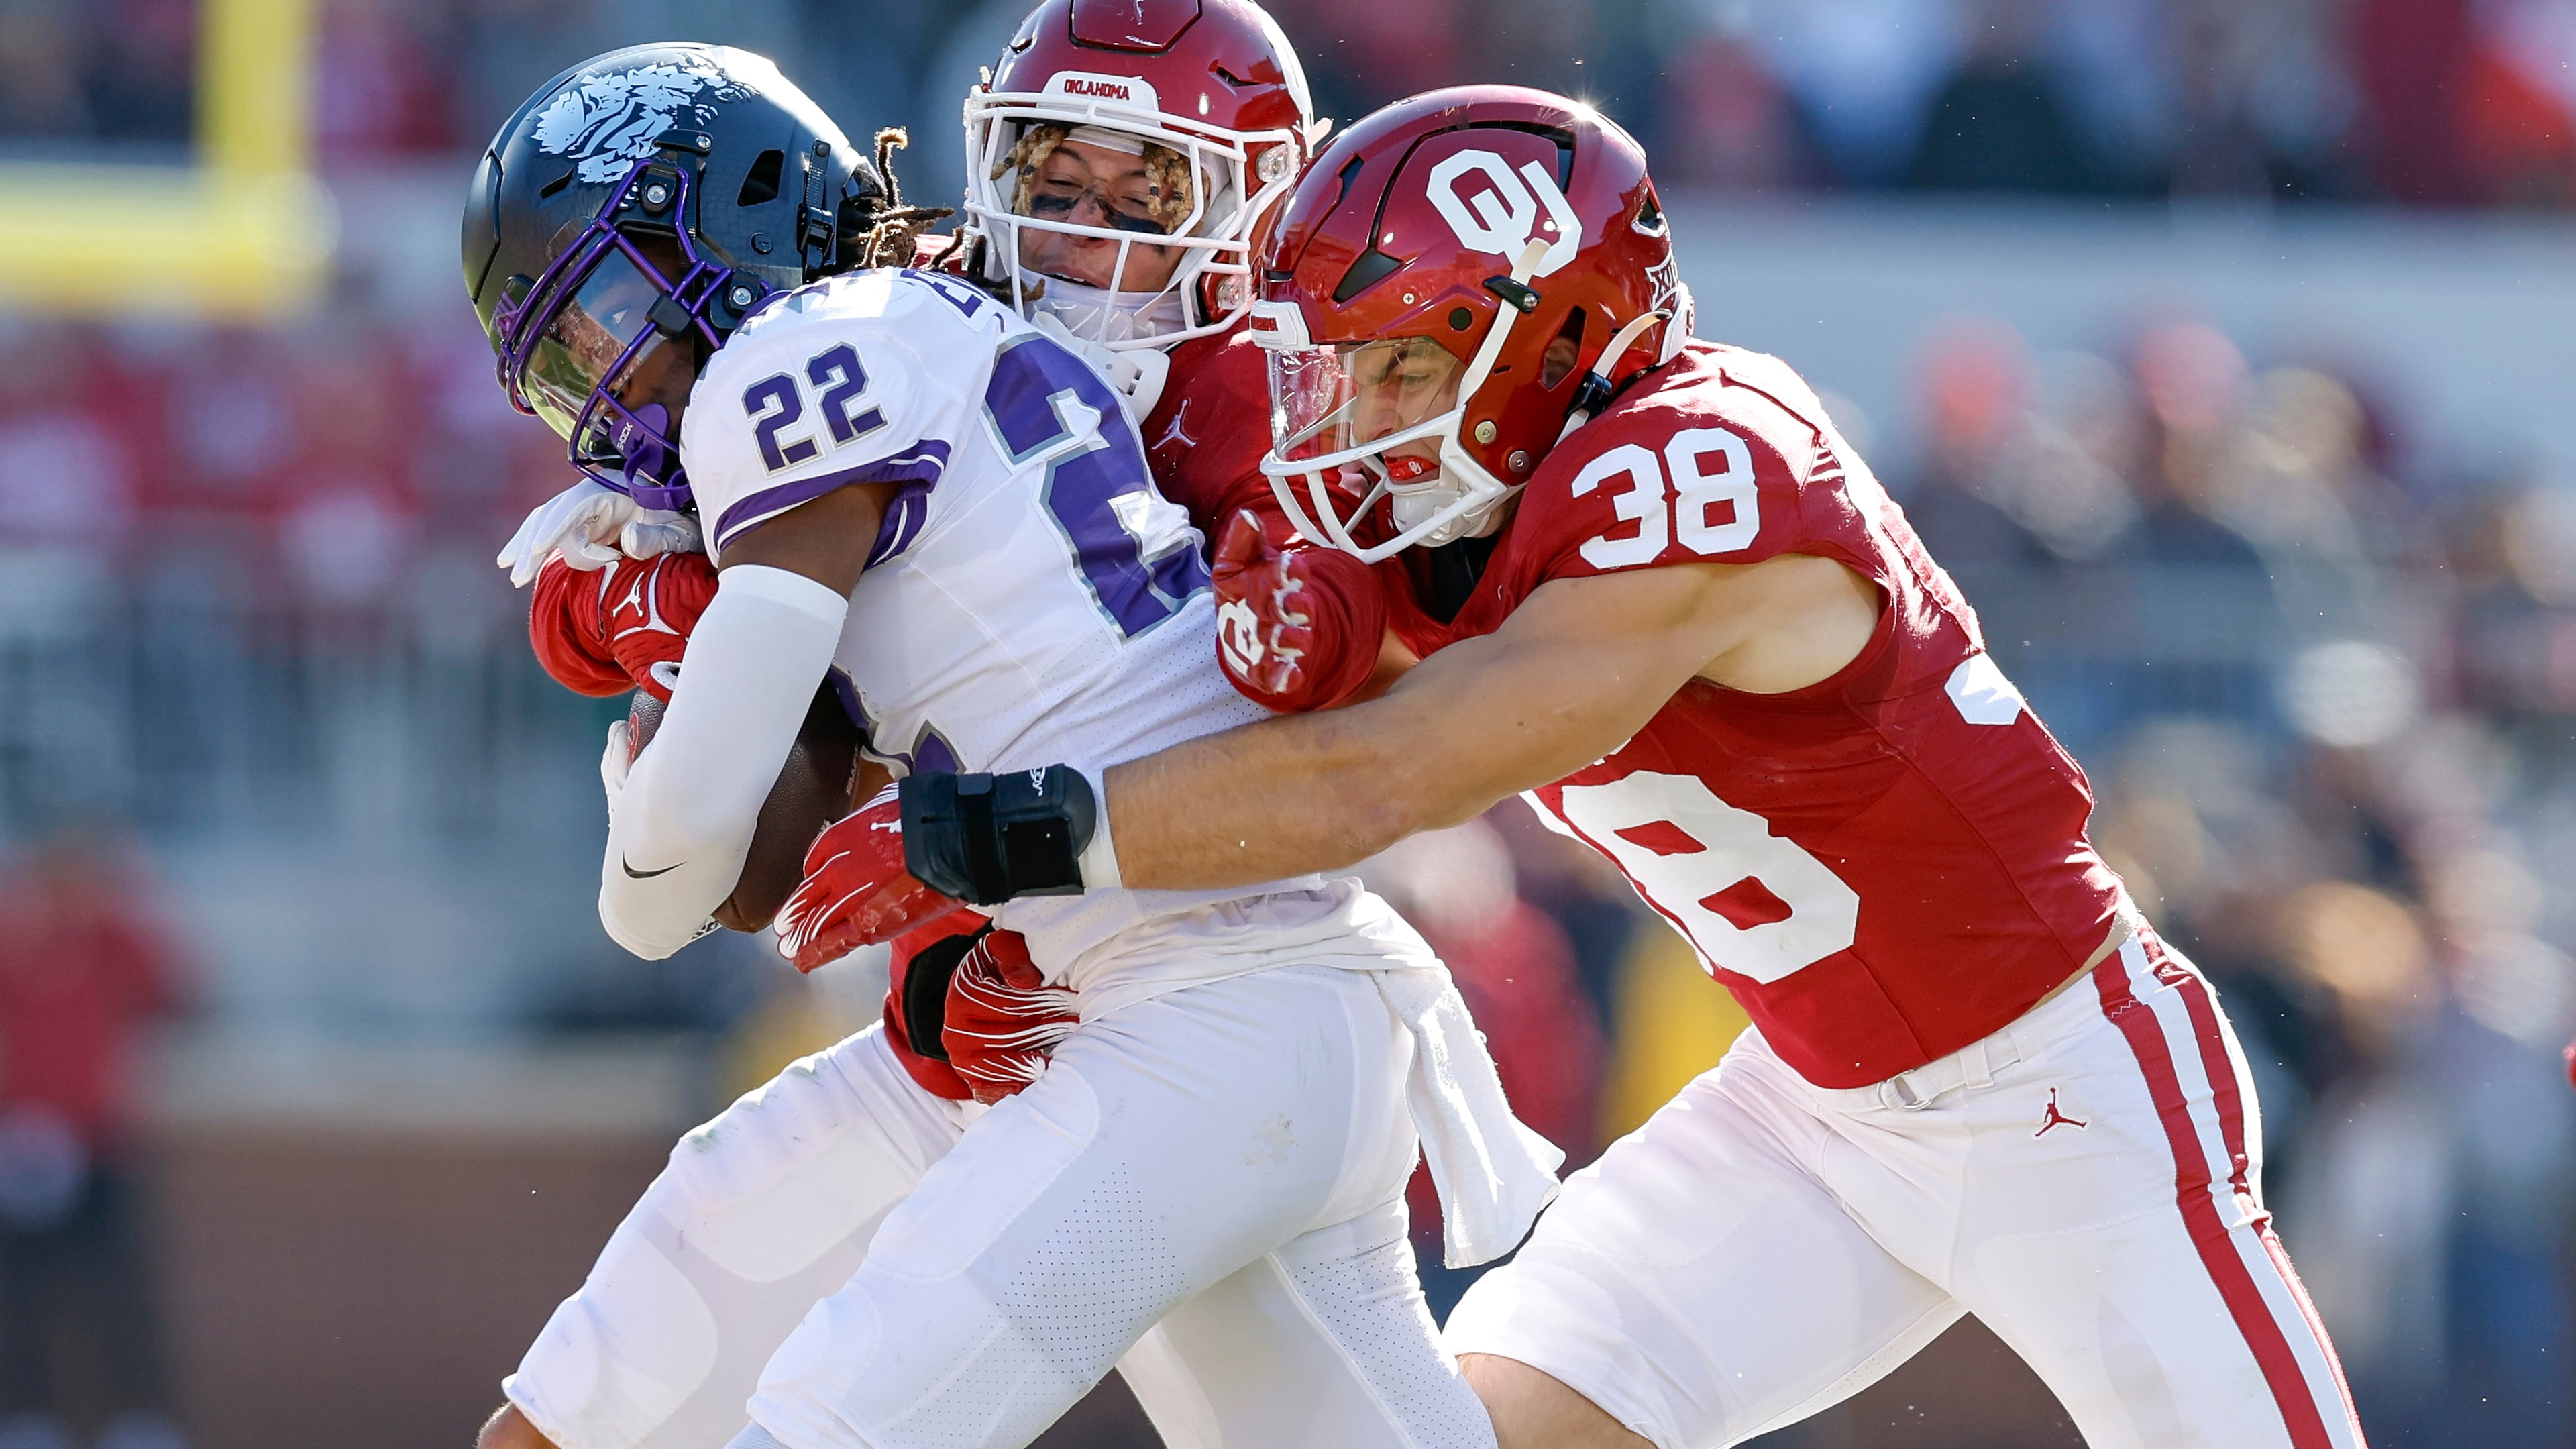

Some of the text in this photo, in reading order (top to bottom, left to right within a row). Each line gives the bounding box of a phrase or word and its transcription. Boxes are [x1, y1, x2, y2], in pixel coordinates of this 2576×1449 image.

[1064, 79, 1130, 101] OKLAHOMA
[1426, 148, 1582, 278] OU
[617, 421, 633, 451] SHOCK
[741, 340, 889, 476] 22
[1571, 427, 1760, 570] 38
[1519, 769, 1860, 985] 8
